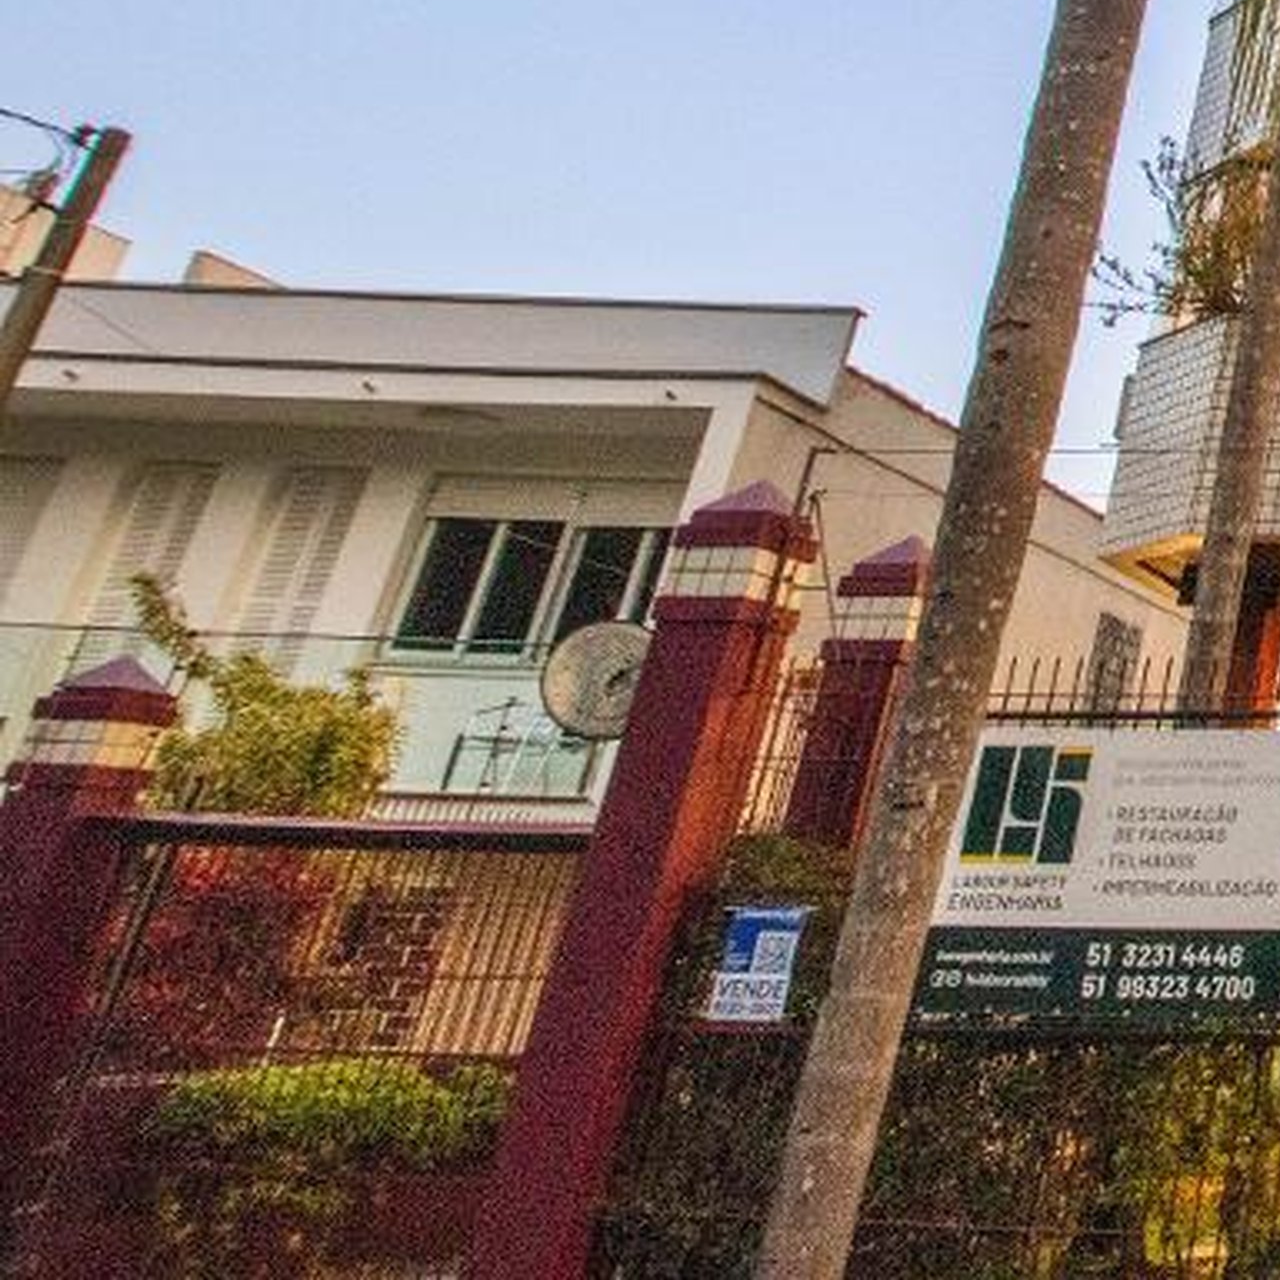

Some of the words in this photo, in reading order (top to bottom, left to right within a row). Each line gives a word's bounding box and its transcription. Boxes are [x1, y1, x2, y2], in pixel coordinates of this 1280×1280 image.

[1112, 827, 1135, 844] DE
[1138, 826, 1228, 844] FACHADAS
[947, 892, 1064, 911] ENGENHARIA
[1085, 942, 1112, 968] 51
[1121, 942, 1176, 968] 3231
[1181, 942, 1245, 968] 4446
[718, 978, 786, 1000] VENDE
[1081, 974, 1107, 1000] 51
[1195, 974, 1256, 1000] 4700
